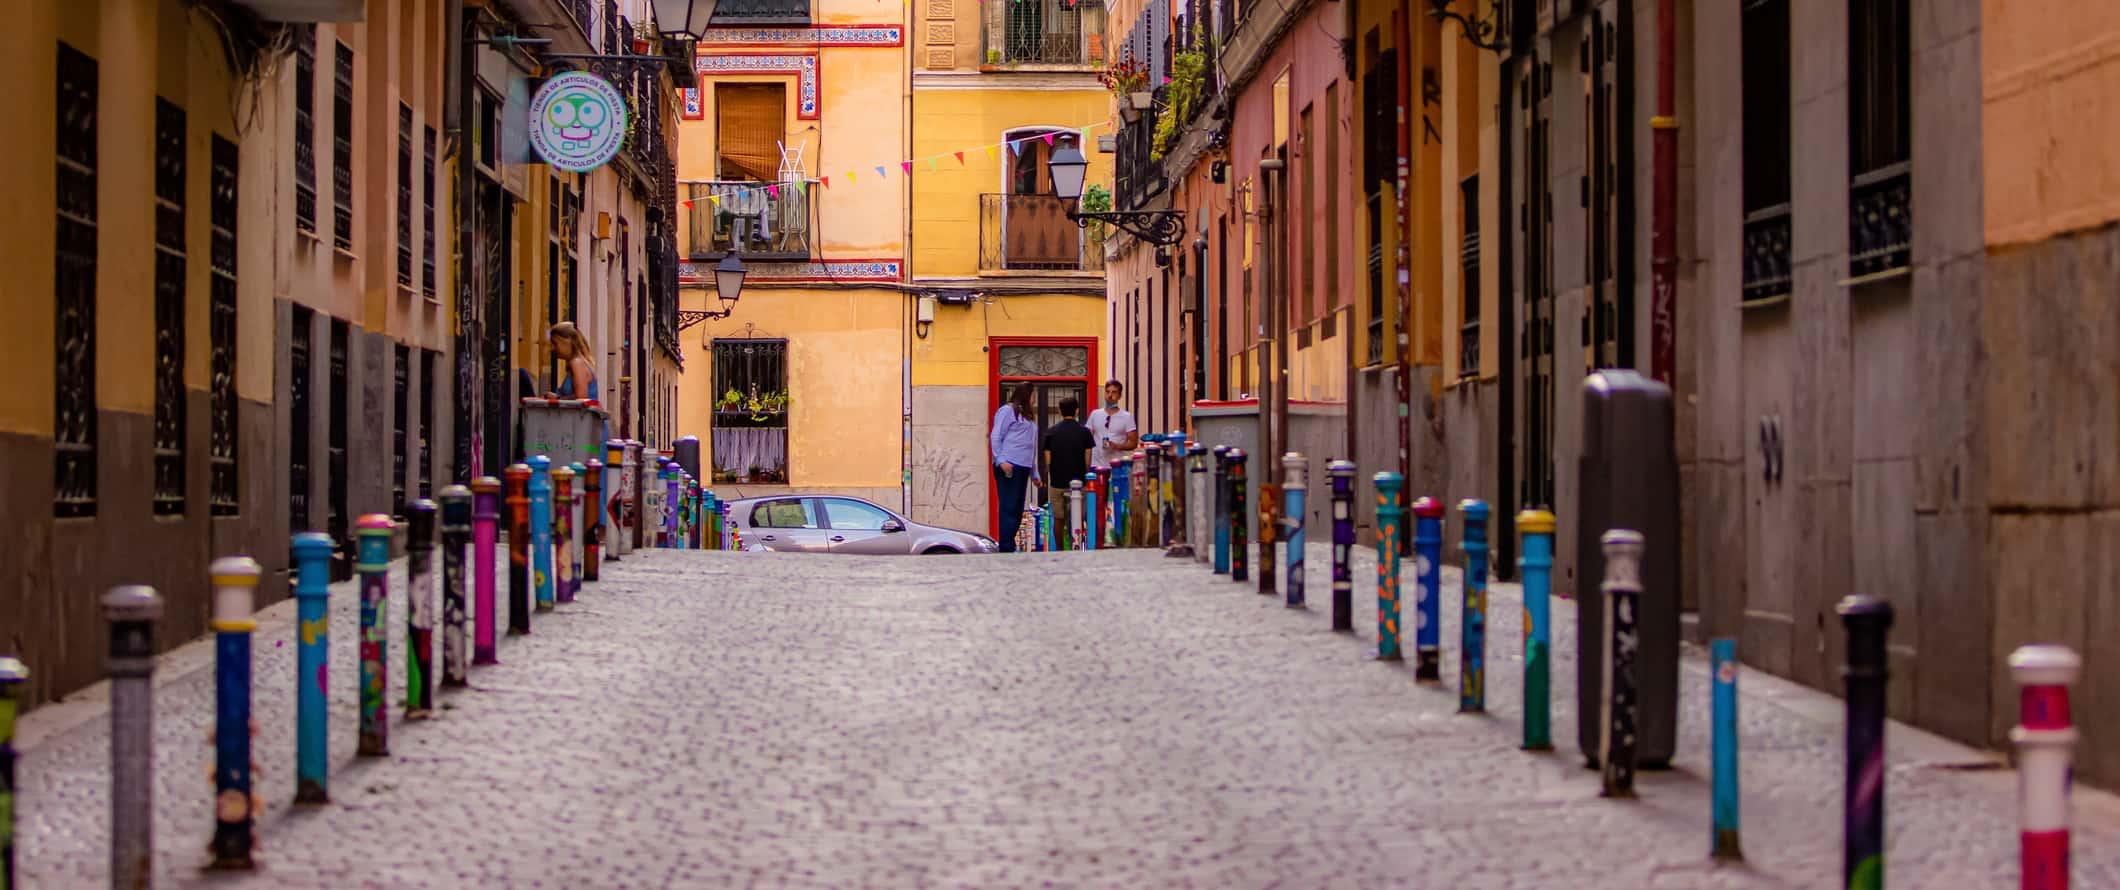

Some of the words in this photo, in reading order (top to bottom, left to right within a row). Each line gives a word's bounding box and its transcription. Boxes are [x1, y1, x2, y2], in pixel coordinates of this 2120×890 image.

[533, 90, 549, 111] TIENDA
[550, 82, 559, 90] DE
[599, 84, 608, 93] DE
[607, 92, 621, 115] FIESTA
[533, 129, 548, 153] TIENDA
[547, 152, 557, 160] DE
[596, 153, 605, 161] DE
[605, 132, 620, 153] FIESTA
